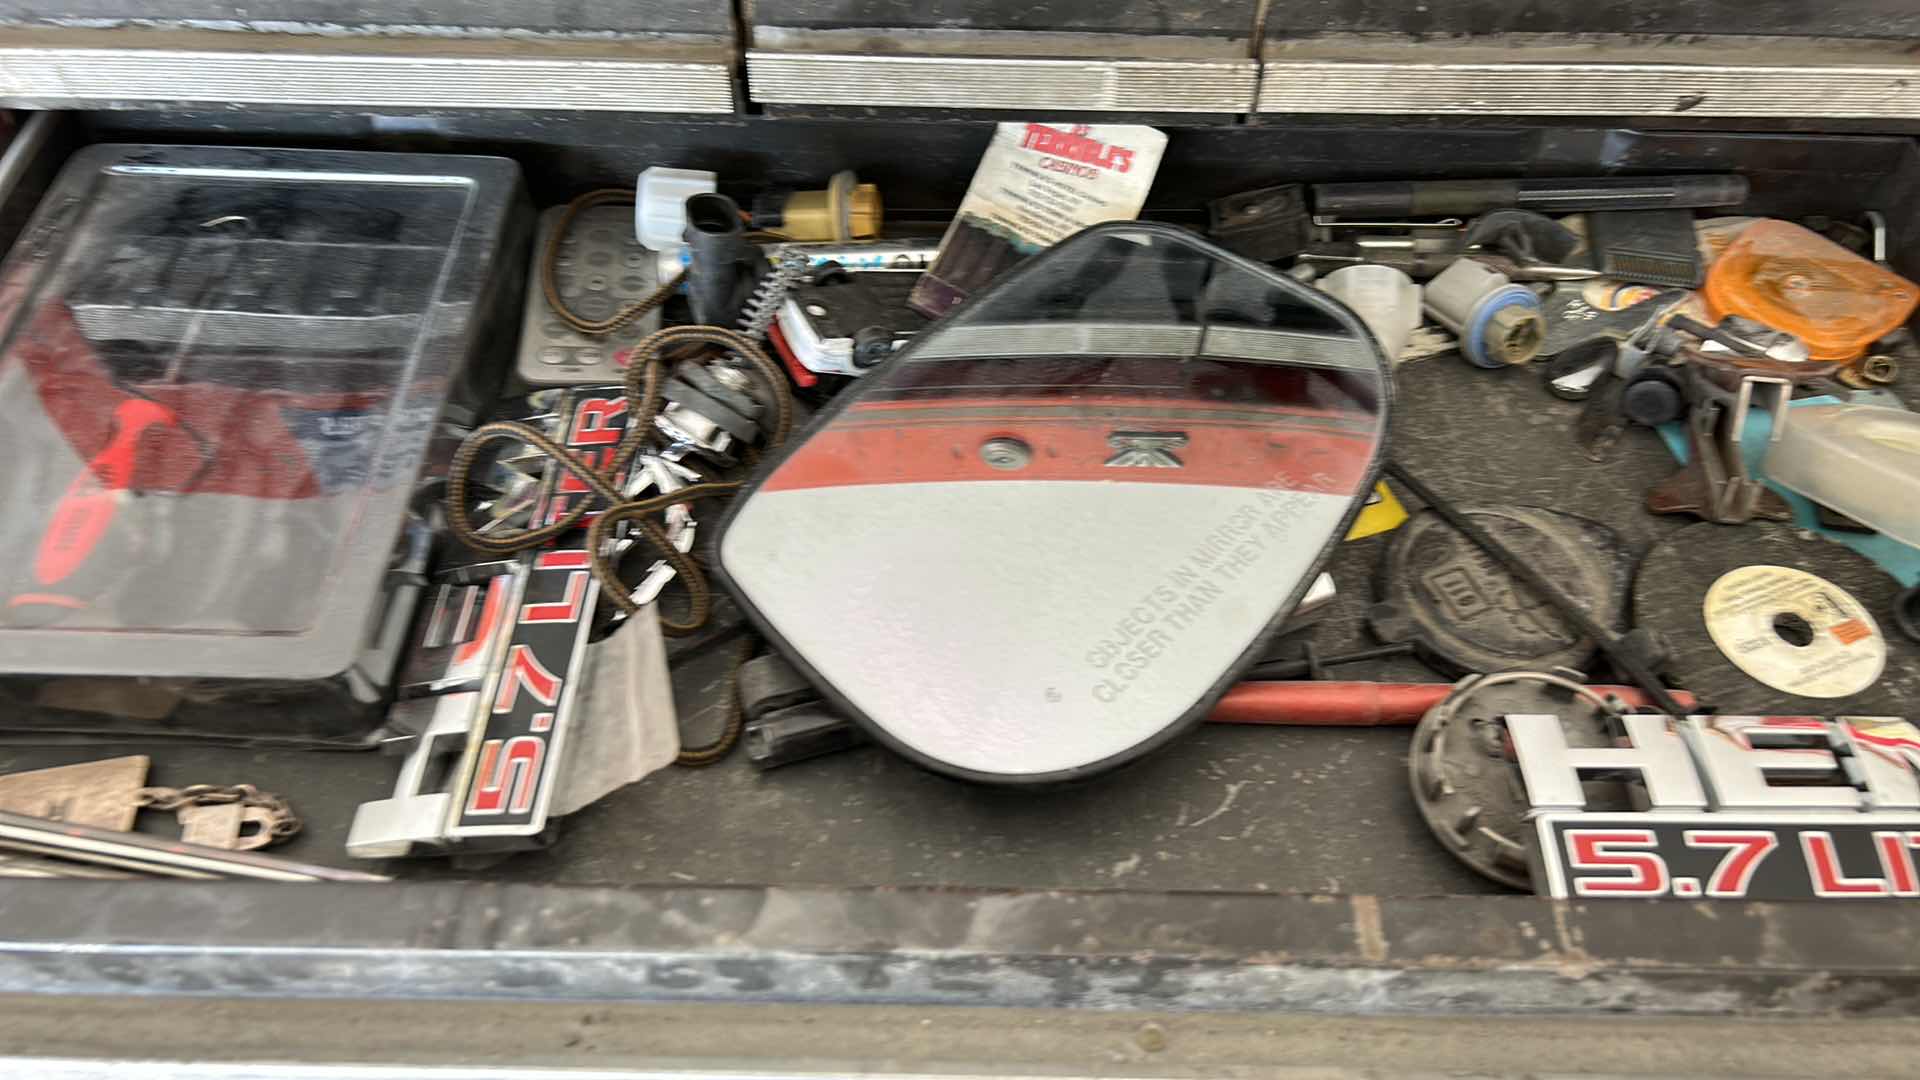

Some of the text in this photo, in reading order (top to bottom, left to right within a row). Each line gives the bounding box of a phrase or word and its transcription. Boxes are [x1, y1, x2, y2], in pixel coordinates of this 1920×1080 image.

[1086, 584, 1176, 668] OBJECTS
[1168, 563, 1196, 589] IN
[1196, 504, 1262, 569] MIRROR
[1091, 628, 1174, 703] CLOSER
[1163, 580, 1224, 631] THAN
[1213, 535, 1268, 580] THEY
[463, 643, 563, 816] 5.7
[1563, 829, 1920, 899] 5.7 LI
